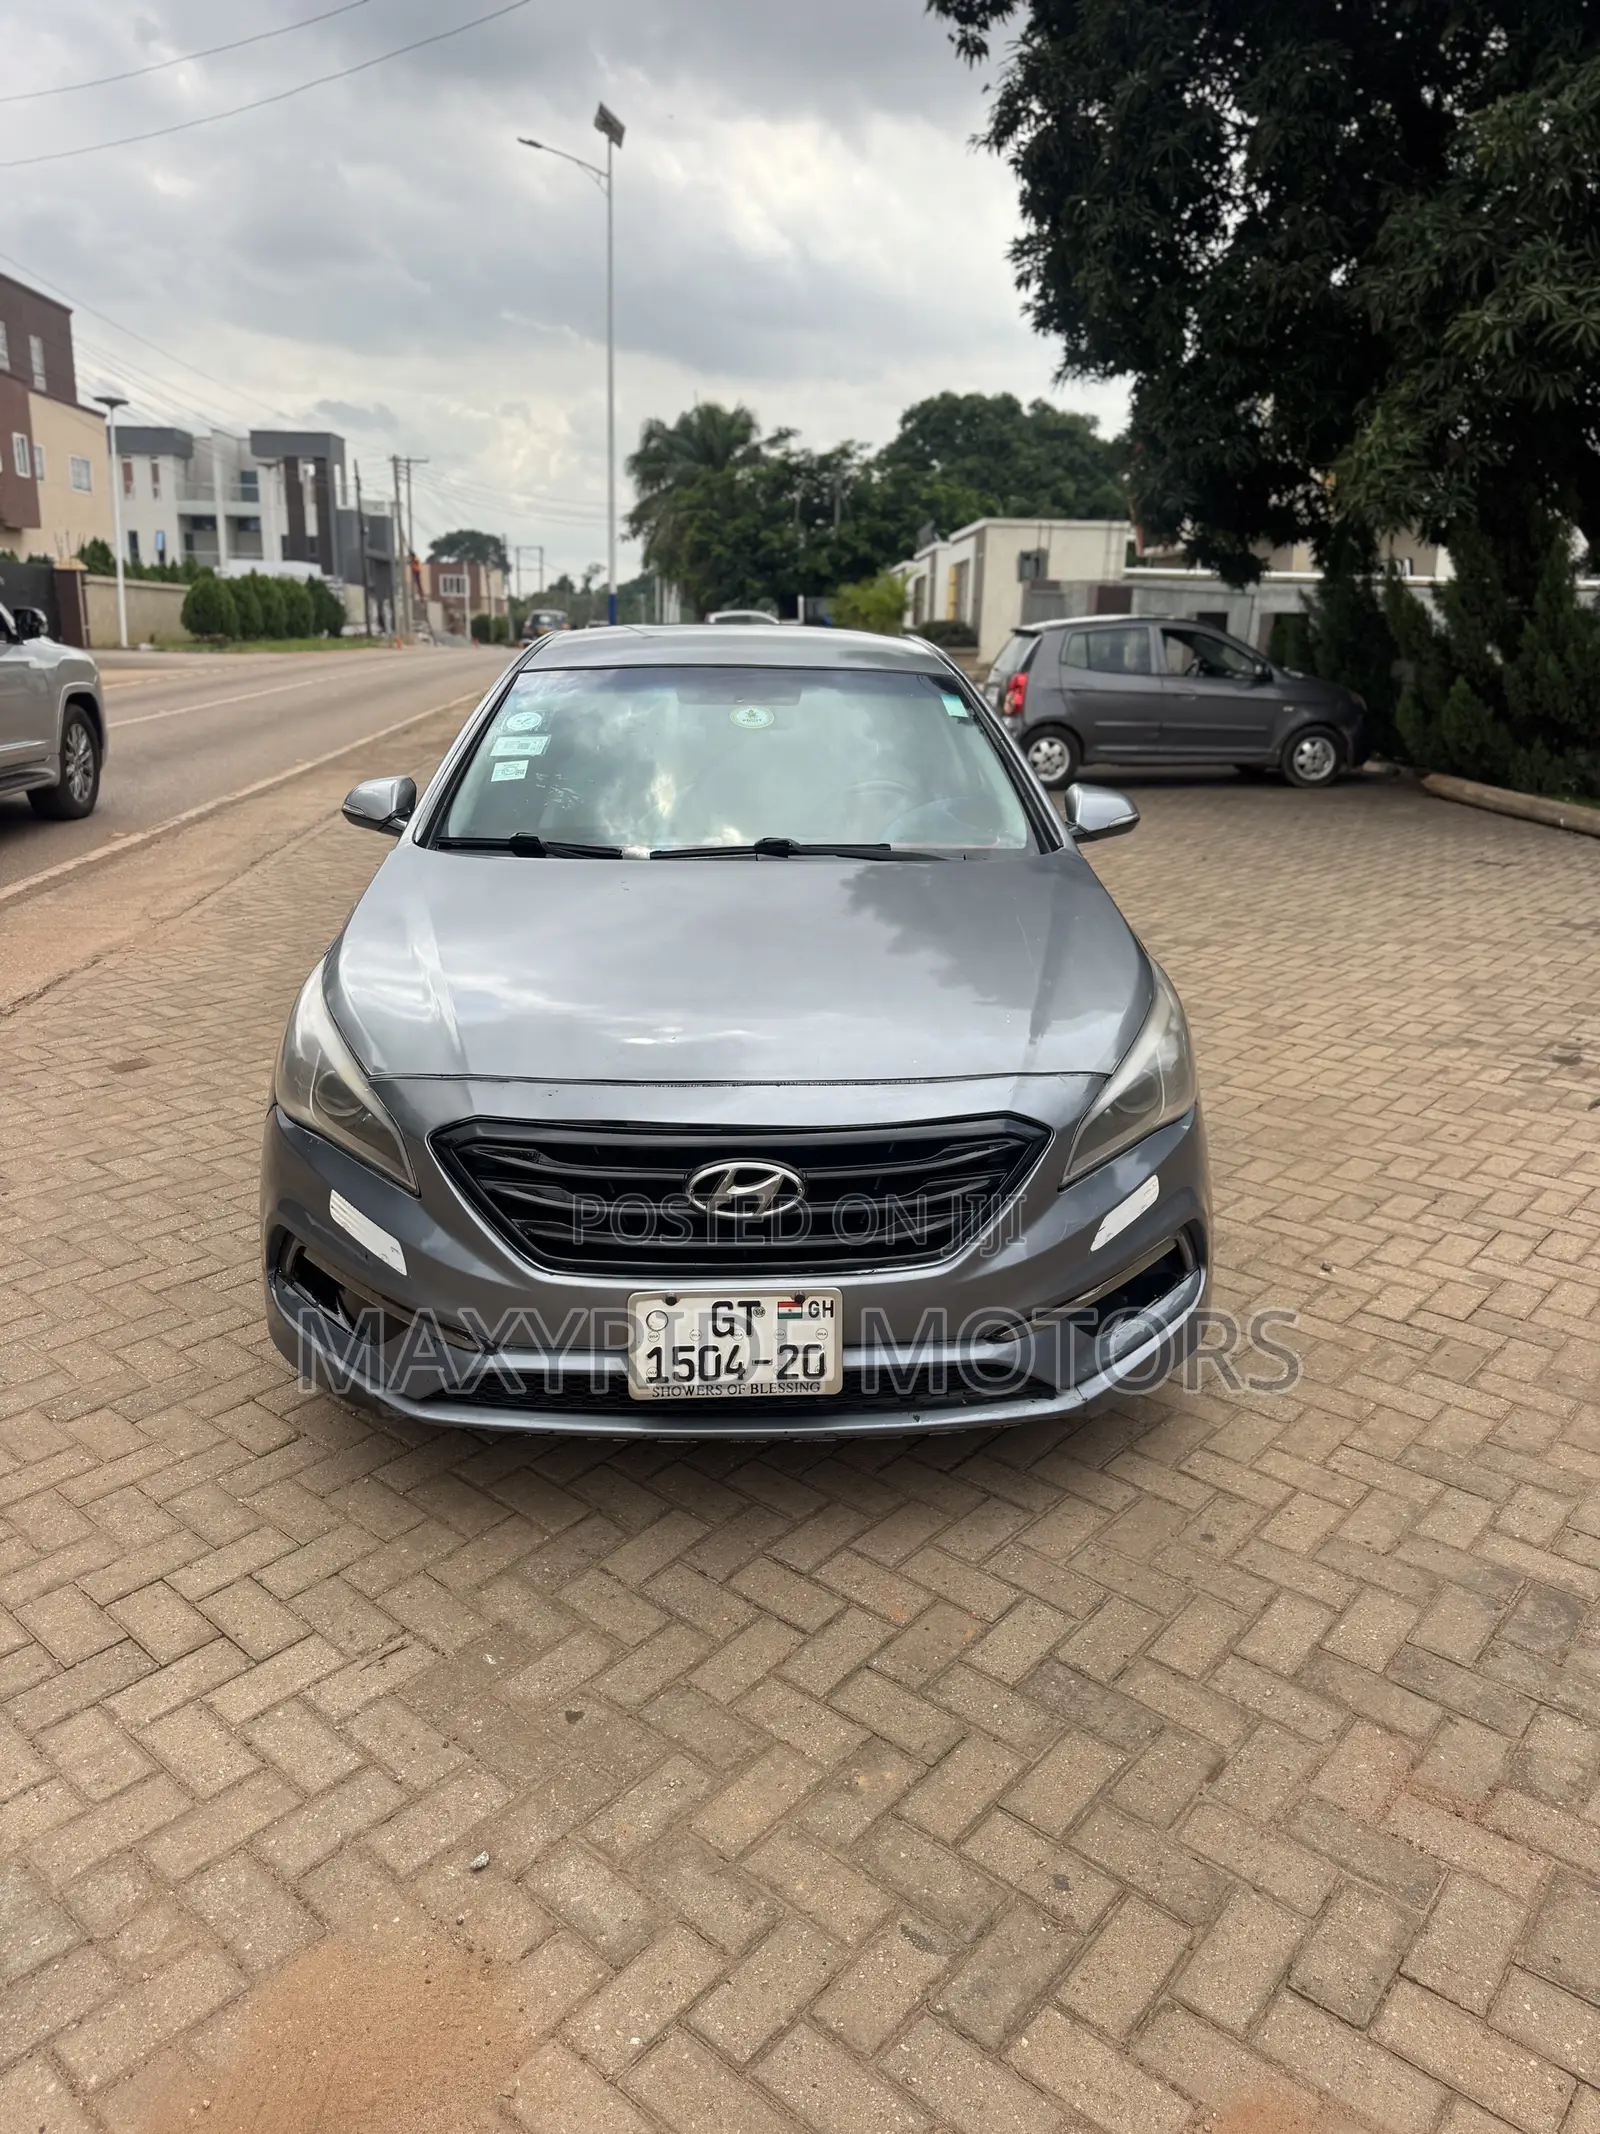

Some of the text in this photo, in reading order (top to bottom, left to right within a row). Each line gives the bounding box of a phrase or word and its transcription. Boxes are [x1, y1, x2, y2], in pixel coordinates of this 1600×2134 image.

[711, 1300, 761, 1337] GT
[808, 1300, 834, 1318] GH
[646, 1344, 826, 1383] 1504-20
[652, 1381, 821, 1398] SHOWERS OF BLESSING
